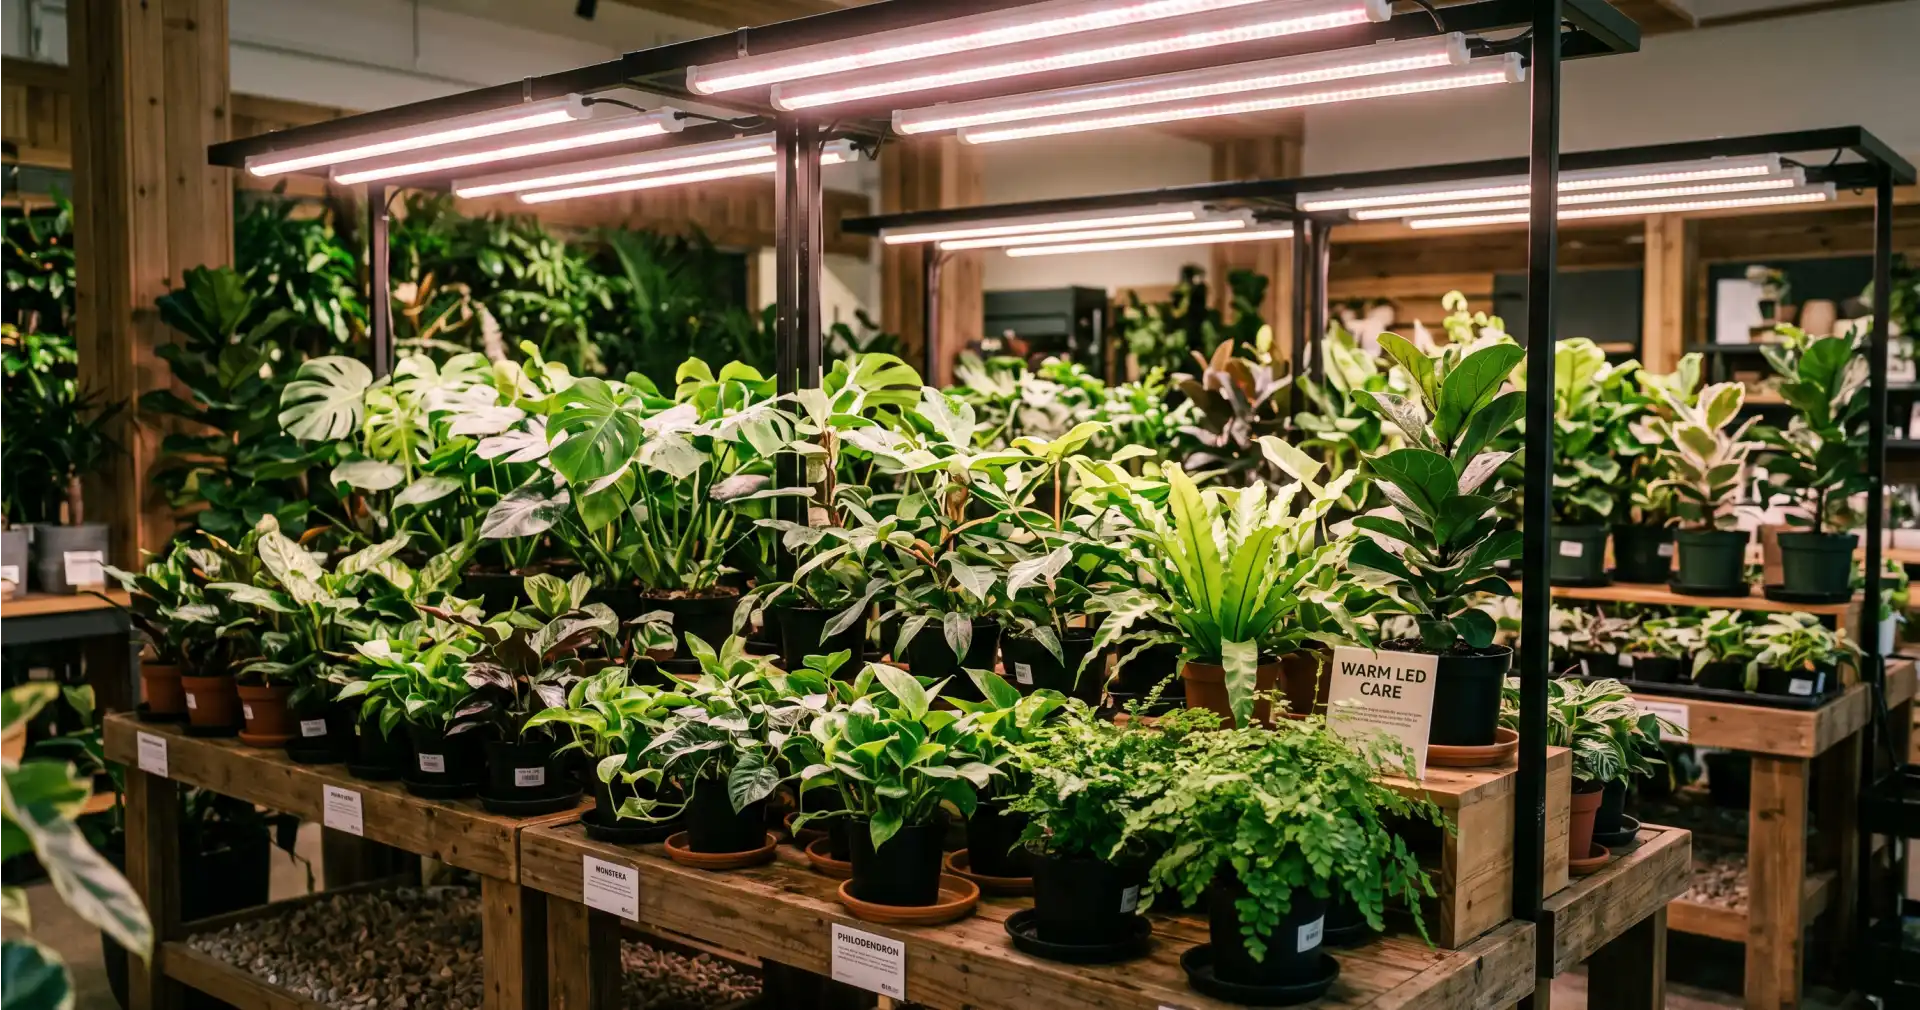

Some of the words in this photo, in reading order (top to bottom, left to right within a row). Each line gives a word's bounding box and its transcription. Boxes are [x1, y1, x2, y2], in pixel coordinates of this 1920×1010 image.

[1341, 661, 1391, 679] WARM
[1396, 667, 1427, 683] LED
[1360, 682, 1402, 699] CARE
[595, 865, 627, 881] MONSTERA
[837, 932, 899, 956] PHILODENDRON
